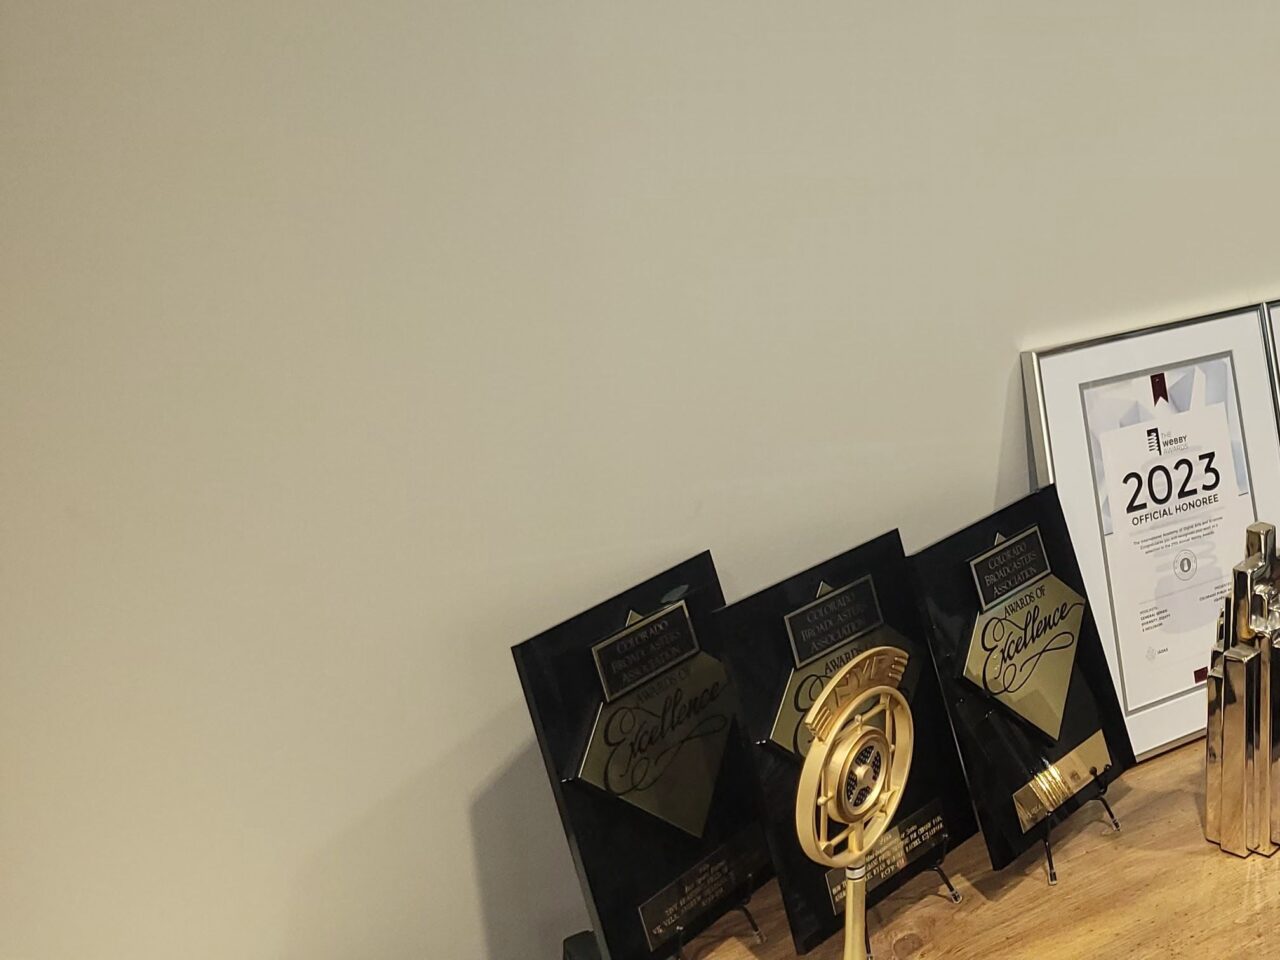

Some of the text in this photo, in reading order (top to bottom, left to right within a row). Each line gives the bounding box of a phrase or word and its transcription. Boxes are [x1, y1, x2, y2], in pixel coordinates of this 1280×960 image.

[1122, 451, 1220, 514] 2023
[1132, 494, 1219, 526] OFFICIAL HONOREE
[984, 551, 1037, 587] BROADCASTERS
[988, 542, 1027, 570] COLORADO
[993, 567, 1037, 598] ASSOCIATION
[1004, 585, 1046, 618] AWARDS OF
[981, 602, 1082, 695] Excellence
[604, 681, 724, 795] Excellence
